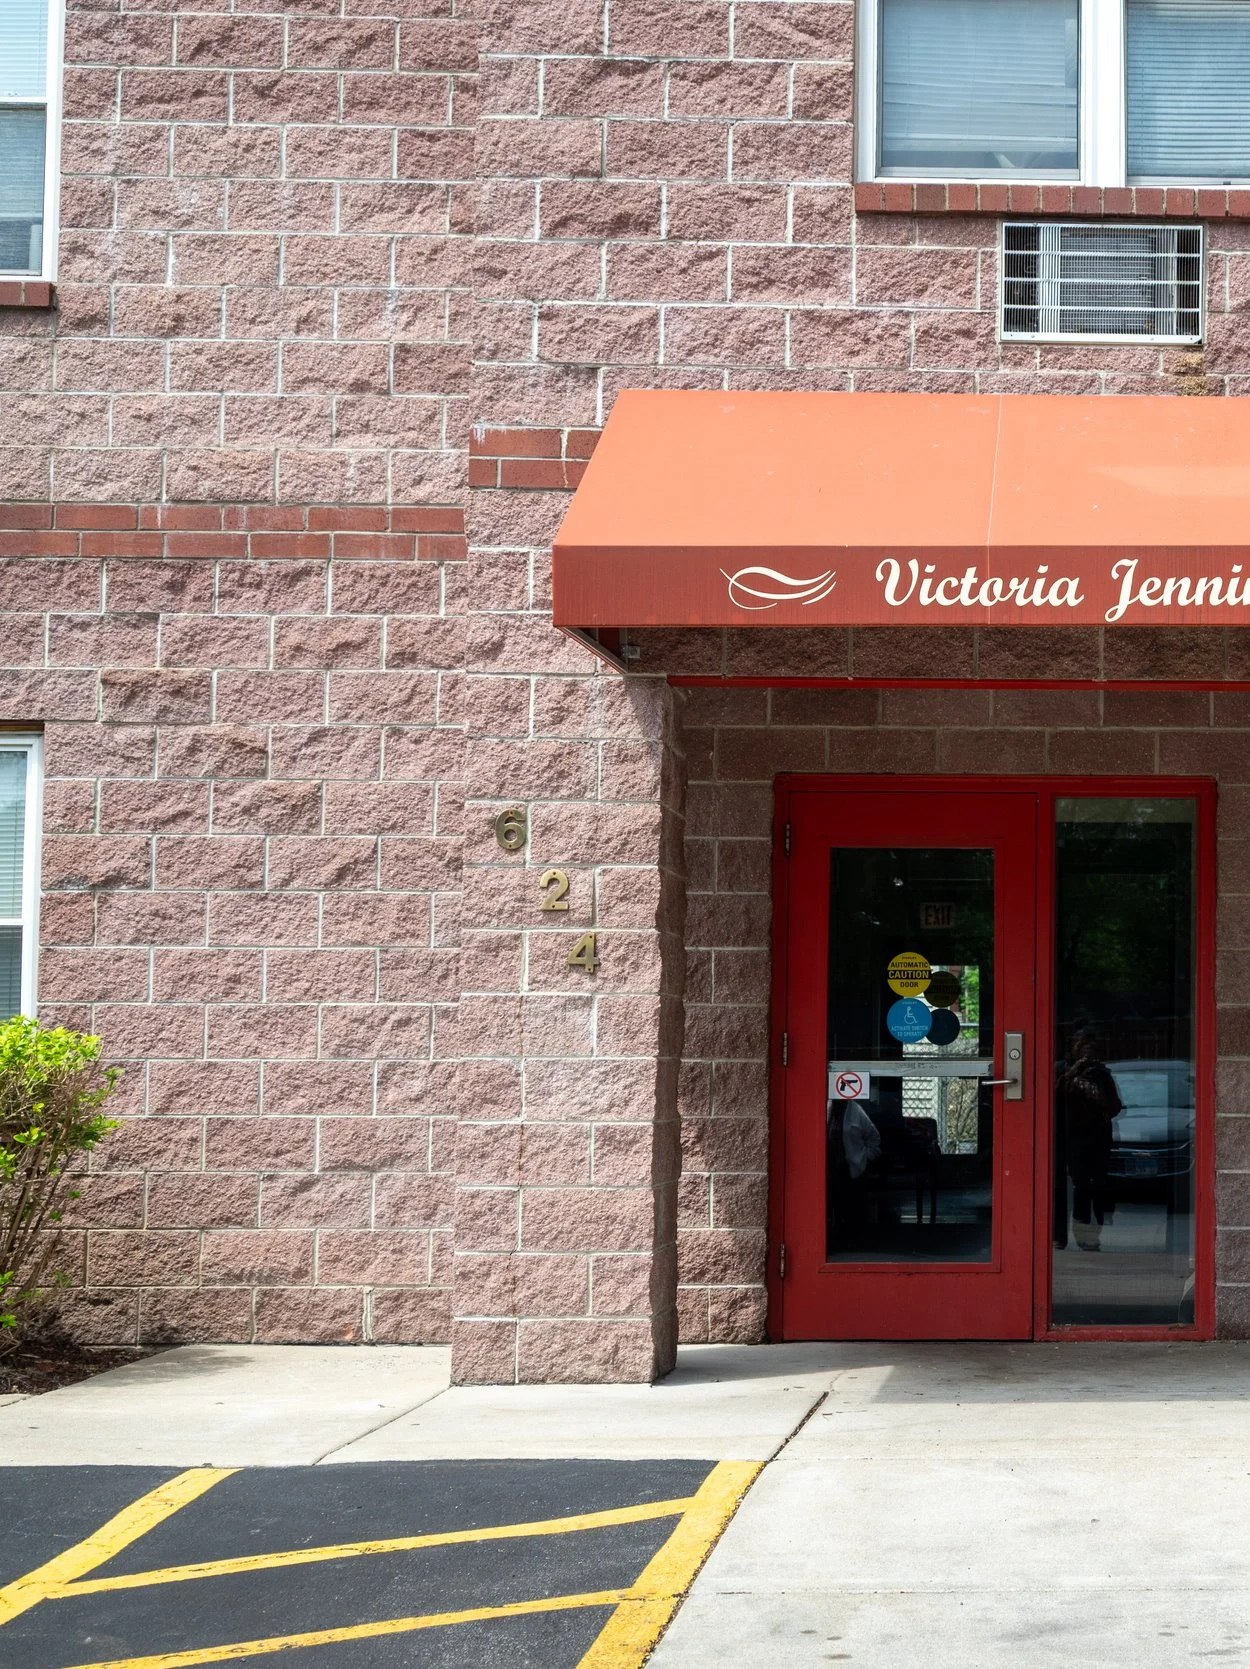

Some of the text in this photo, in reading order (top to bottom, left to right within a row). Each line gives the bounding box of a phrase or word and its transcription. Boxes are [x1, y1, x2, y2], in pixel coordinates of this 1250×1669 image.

[875, 558, 1084, 608] Victoria
[925, 904, 951, 926] EXIT
[890, 961, 928, 969] AUTOMATIC
[888, 970, 929, 979] CAUTION
